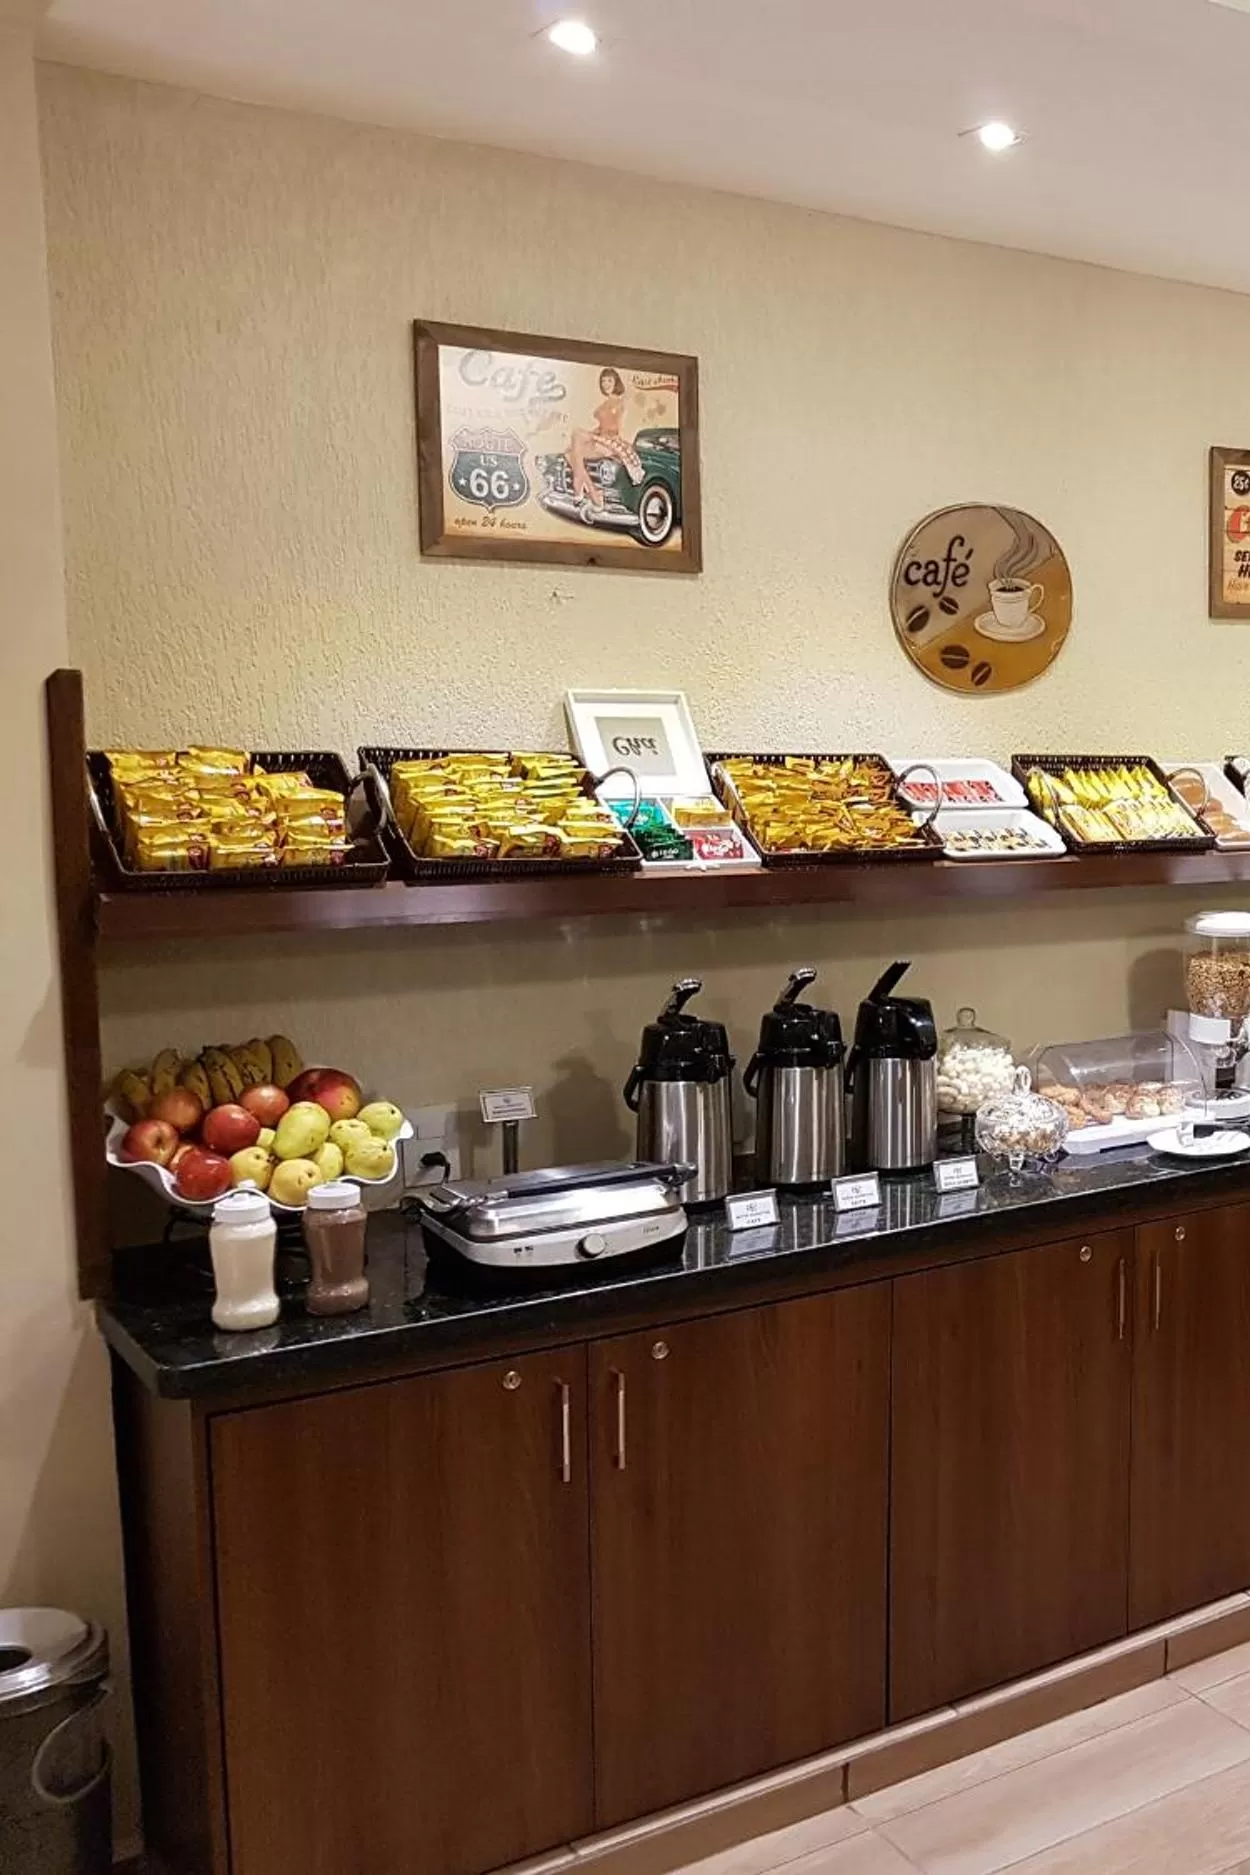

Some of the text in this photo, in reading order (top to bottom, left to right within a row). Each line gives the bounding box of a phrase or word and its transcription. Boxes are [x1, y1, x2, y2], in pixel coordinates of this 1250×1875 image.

[480, 454, 498, 467] US
[469, 468, 510, 499] 66
[904, 534, 974, 598] café
